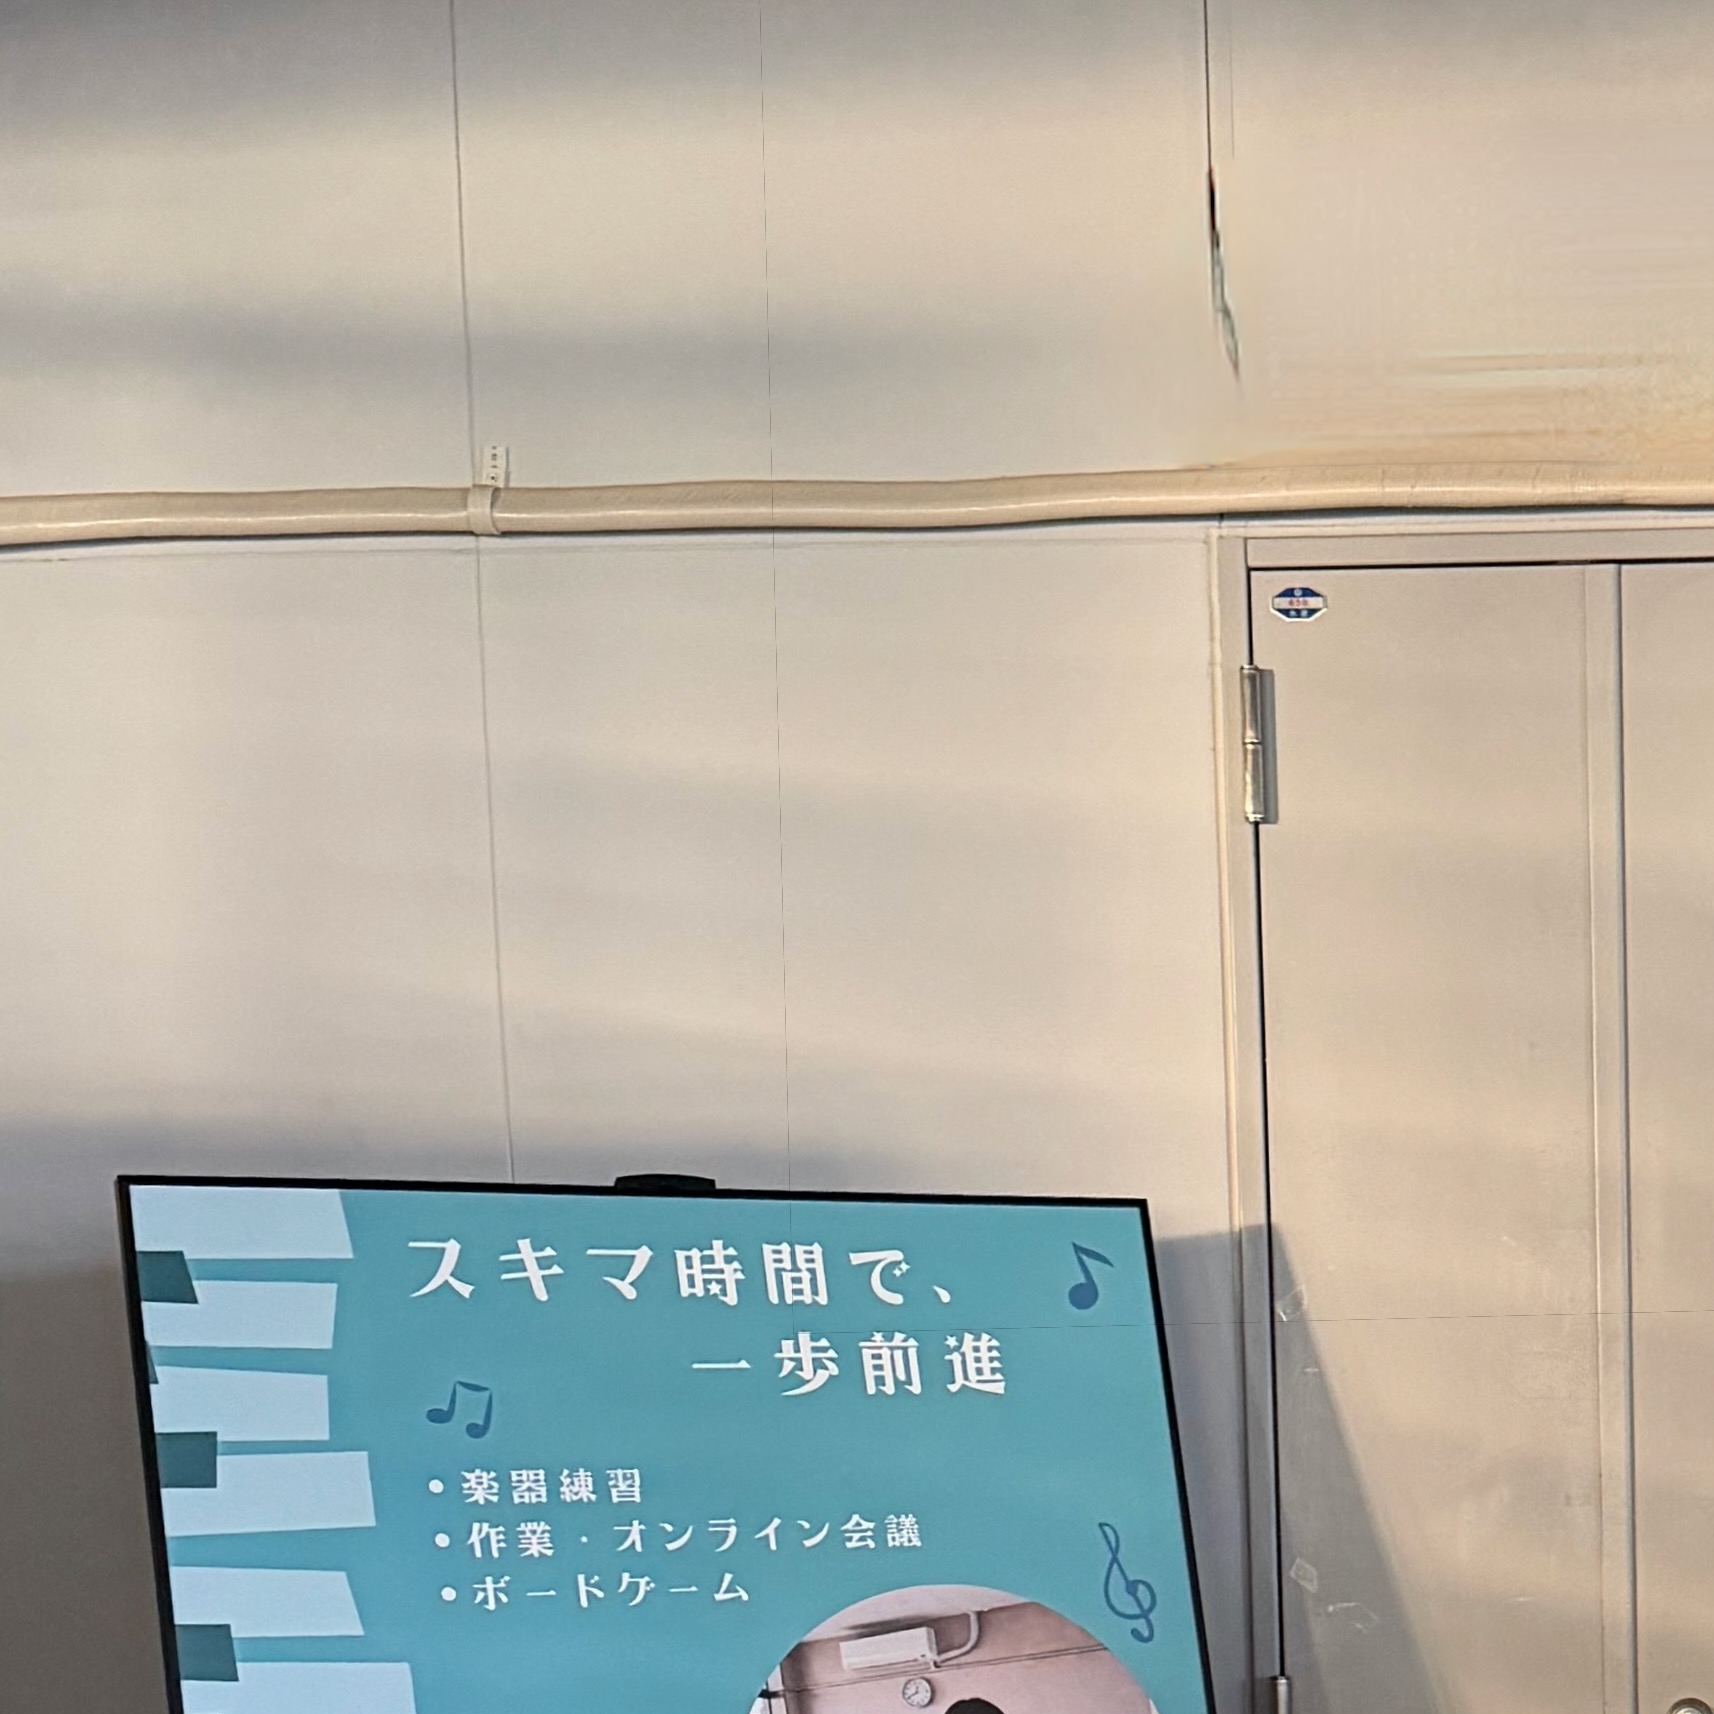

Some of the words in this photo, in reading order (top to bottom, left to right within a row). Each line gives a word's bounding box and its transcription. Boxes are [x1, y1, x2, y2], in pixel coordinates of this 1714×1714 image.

[407, 1237, 952, 1306] スキマ時間で、
[691, 1331, 1008, 1396] 一歩前進
[460, 1467, 643, 1505] 楽器練習
[466, 1513, 922, 1559] 作業・オンライン会議
[472, 1573, 750, 1611] ボードゲーム
